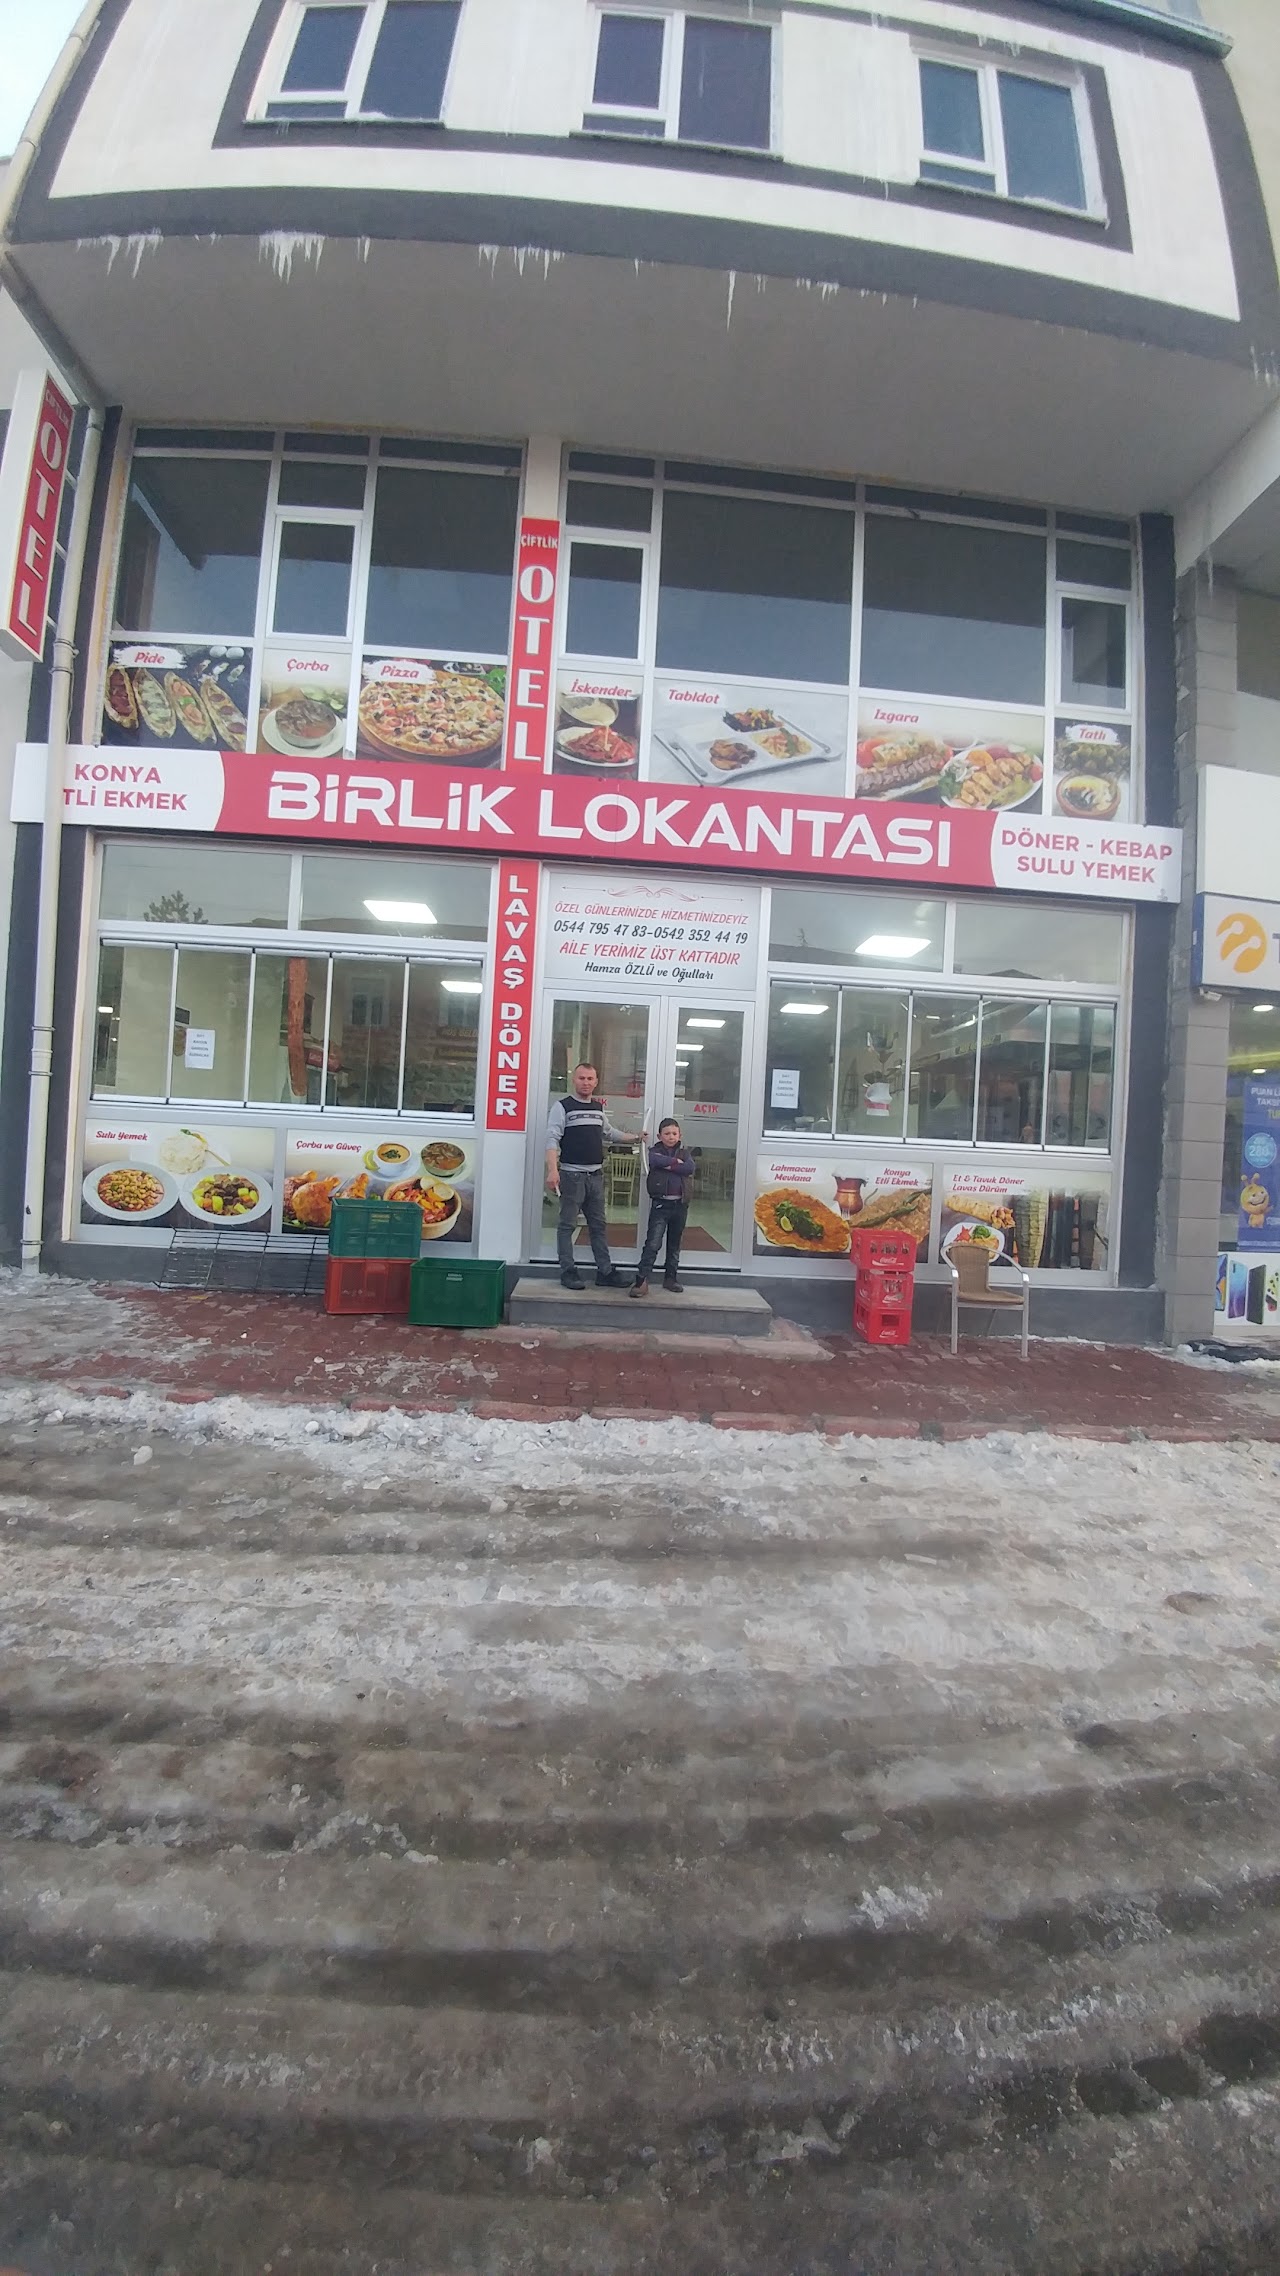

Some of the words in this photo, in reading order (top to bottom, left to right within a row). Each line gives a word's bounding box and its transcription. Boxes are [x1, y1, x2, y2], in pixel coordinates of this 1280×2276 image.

[18, 421, 62, 637] OTEL
[520, 533, 558, 549] ÇİFTLİK
[134, 651, 166, 665] Pide
[286, 658, 330, 673] Çorba
[513, 565, 554, 762] OTEL
[380, 664, 419, 680] Pizza
[570, 678, 632, 697] İskender
[668, 689, 720, 704] Tabldot
[873, 708, 919, 725] Izgara
[74, 763, 162, 784] KONYA
[63, 786, 96, 807] TLİ
[103, 790, 188, 811] EKMEK
[537, 789, 951, 867] LOKANTASI
[1001, 827, 1080, 852] DÖNER
[1100, 838, 1173, 861] KEBAP
[1017, 856, 1075, 876] SULU
[1082, 861, 1157, 884] YEMEK
[555, 901, 580, 914] ÖZEL
[584, 903, 659, 919] GÜNLERİNİZDE
[502, 875, 529, 990] LAVAŞ
[554, 919, 585, 934] 0544
[589, 922, 610, 935] 795
[614, 924, 630, 936] 47
[688, 928, 711, 942] 352
[715, 931, 731, 943] 44
[735, 932, 748, 944] 19
[559, 939, 590, 955] AİLE
[594, 942, 647, 959] YERİMİZ
[650, 944, 677, 961] ÜST
[678, 949, 741, 965] KATTADIR
[584, 961, 621, 974] Hamza
[624, 962, 655, 976] ÖZLÜ
[657, 969, 668, 977] ve
[671, 967, 714, 983] Oğulları
[495, 1003, 523, 1117] DÖNER
[693, 1103, 719, 1114] AÇIK
[95, 1130, 117, 1139] Sulu
[118, 1132, 148, 1142] Yemek
[296, 1140, 323, 1150] Çorba
[336, 1142, 362, 1153] Güveç
[770, 1163, 816, 1174] Lahmacun
[883, 1168, 911, 1179] Konya
[774, 1173, 812, 1183] Mevlana
[875, 1177, 889, 1185] Etli
[891, 1177, 919, 1187] Ekmek
[952, 1174, 962, 1182] Et
[972, 1175, 997, 1184] Tavuk
[998, 1176, 1024, 1185] Döner
[978, 1185, 1008, 1193] Dürüm
